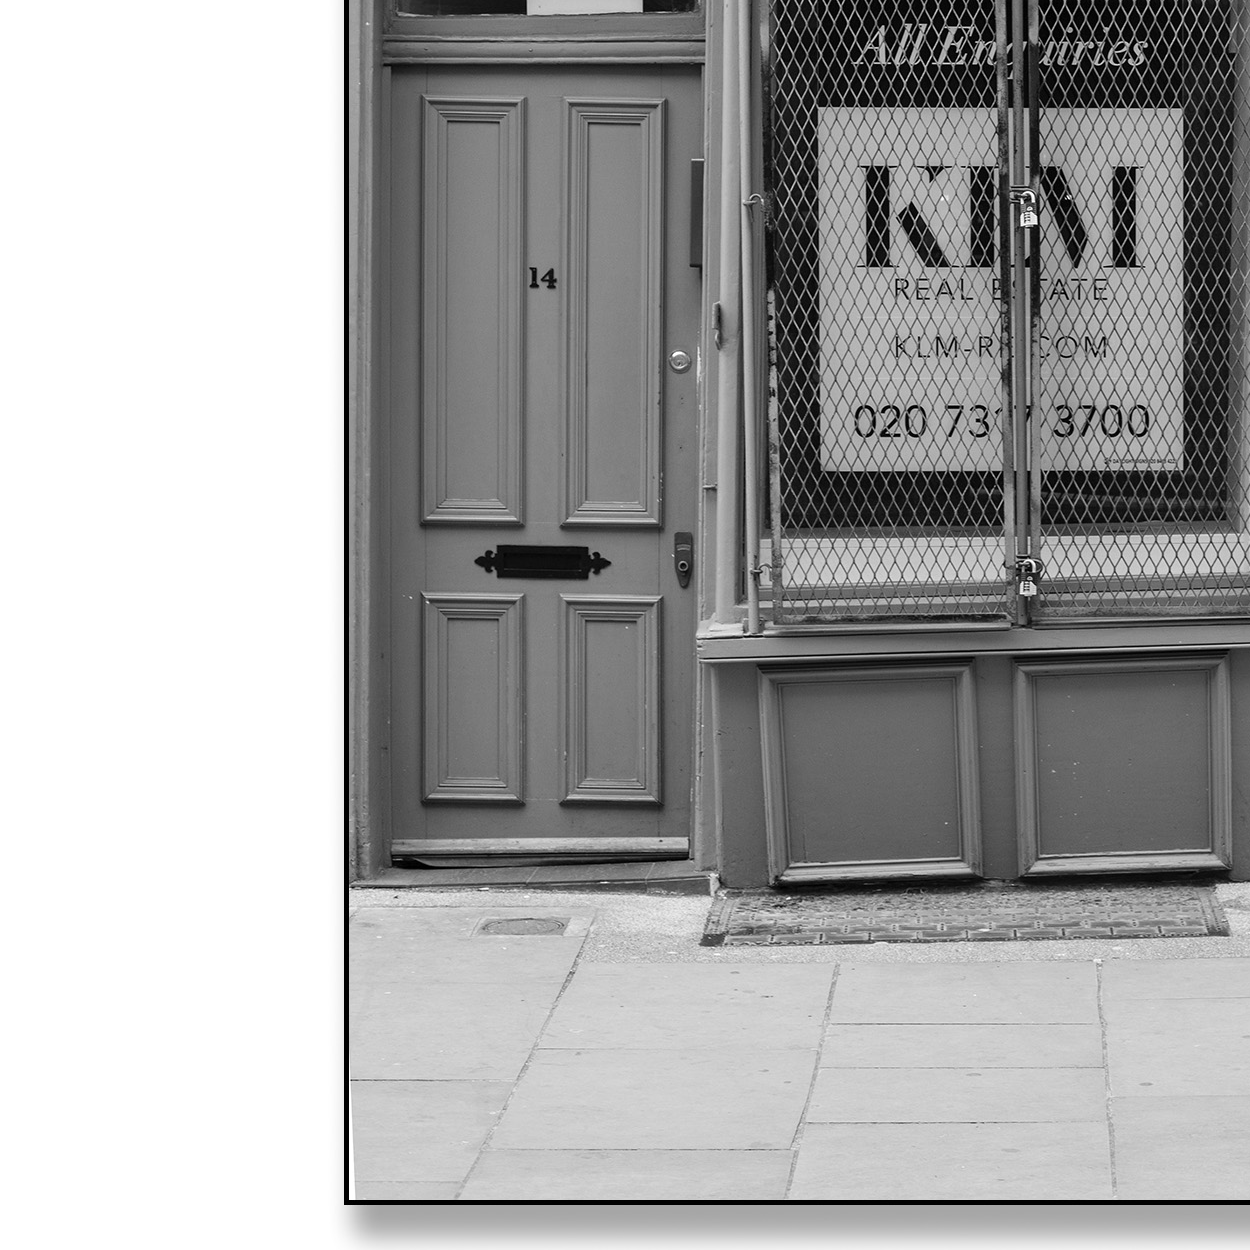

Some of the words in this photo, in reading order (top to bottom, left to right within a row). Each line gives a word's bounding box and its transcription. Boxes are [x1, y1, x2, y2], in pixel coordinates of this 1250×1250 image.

[851, 23, 928, 66] All
[856, 165, 1146, 269] KLM
[529, 267, 557, 289] 14
[895, 278, 974, 300] REAL
[993, 278, 1108, 300] EATE
[895, 335, 1107, 358] KLM-ROM
[854, 404, 927, 438] 020
[945, 404, 1032, 438] 737
[1053, 404, 1149, 438] 3700
